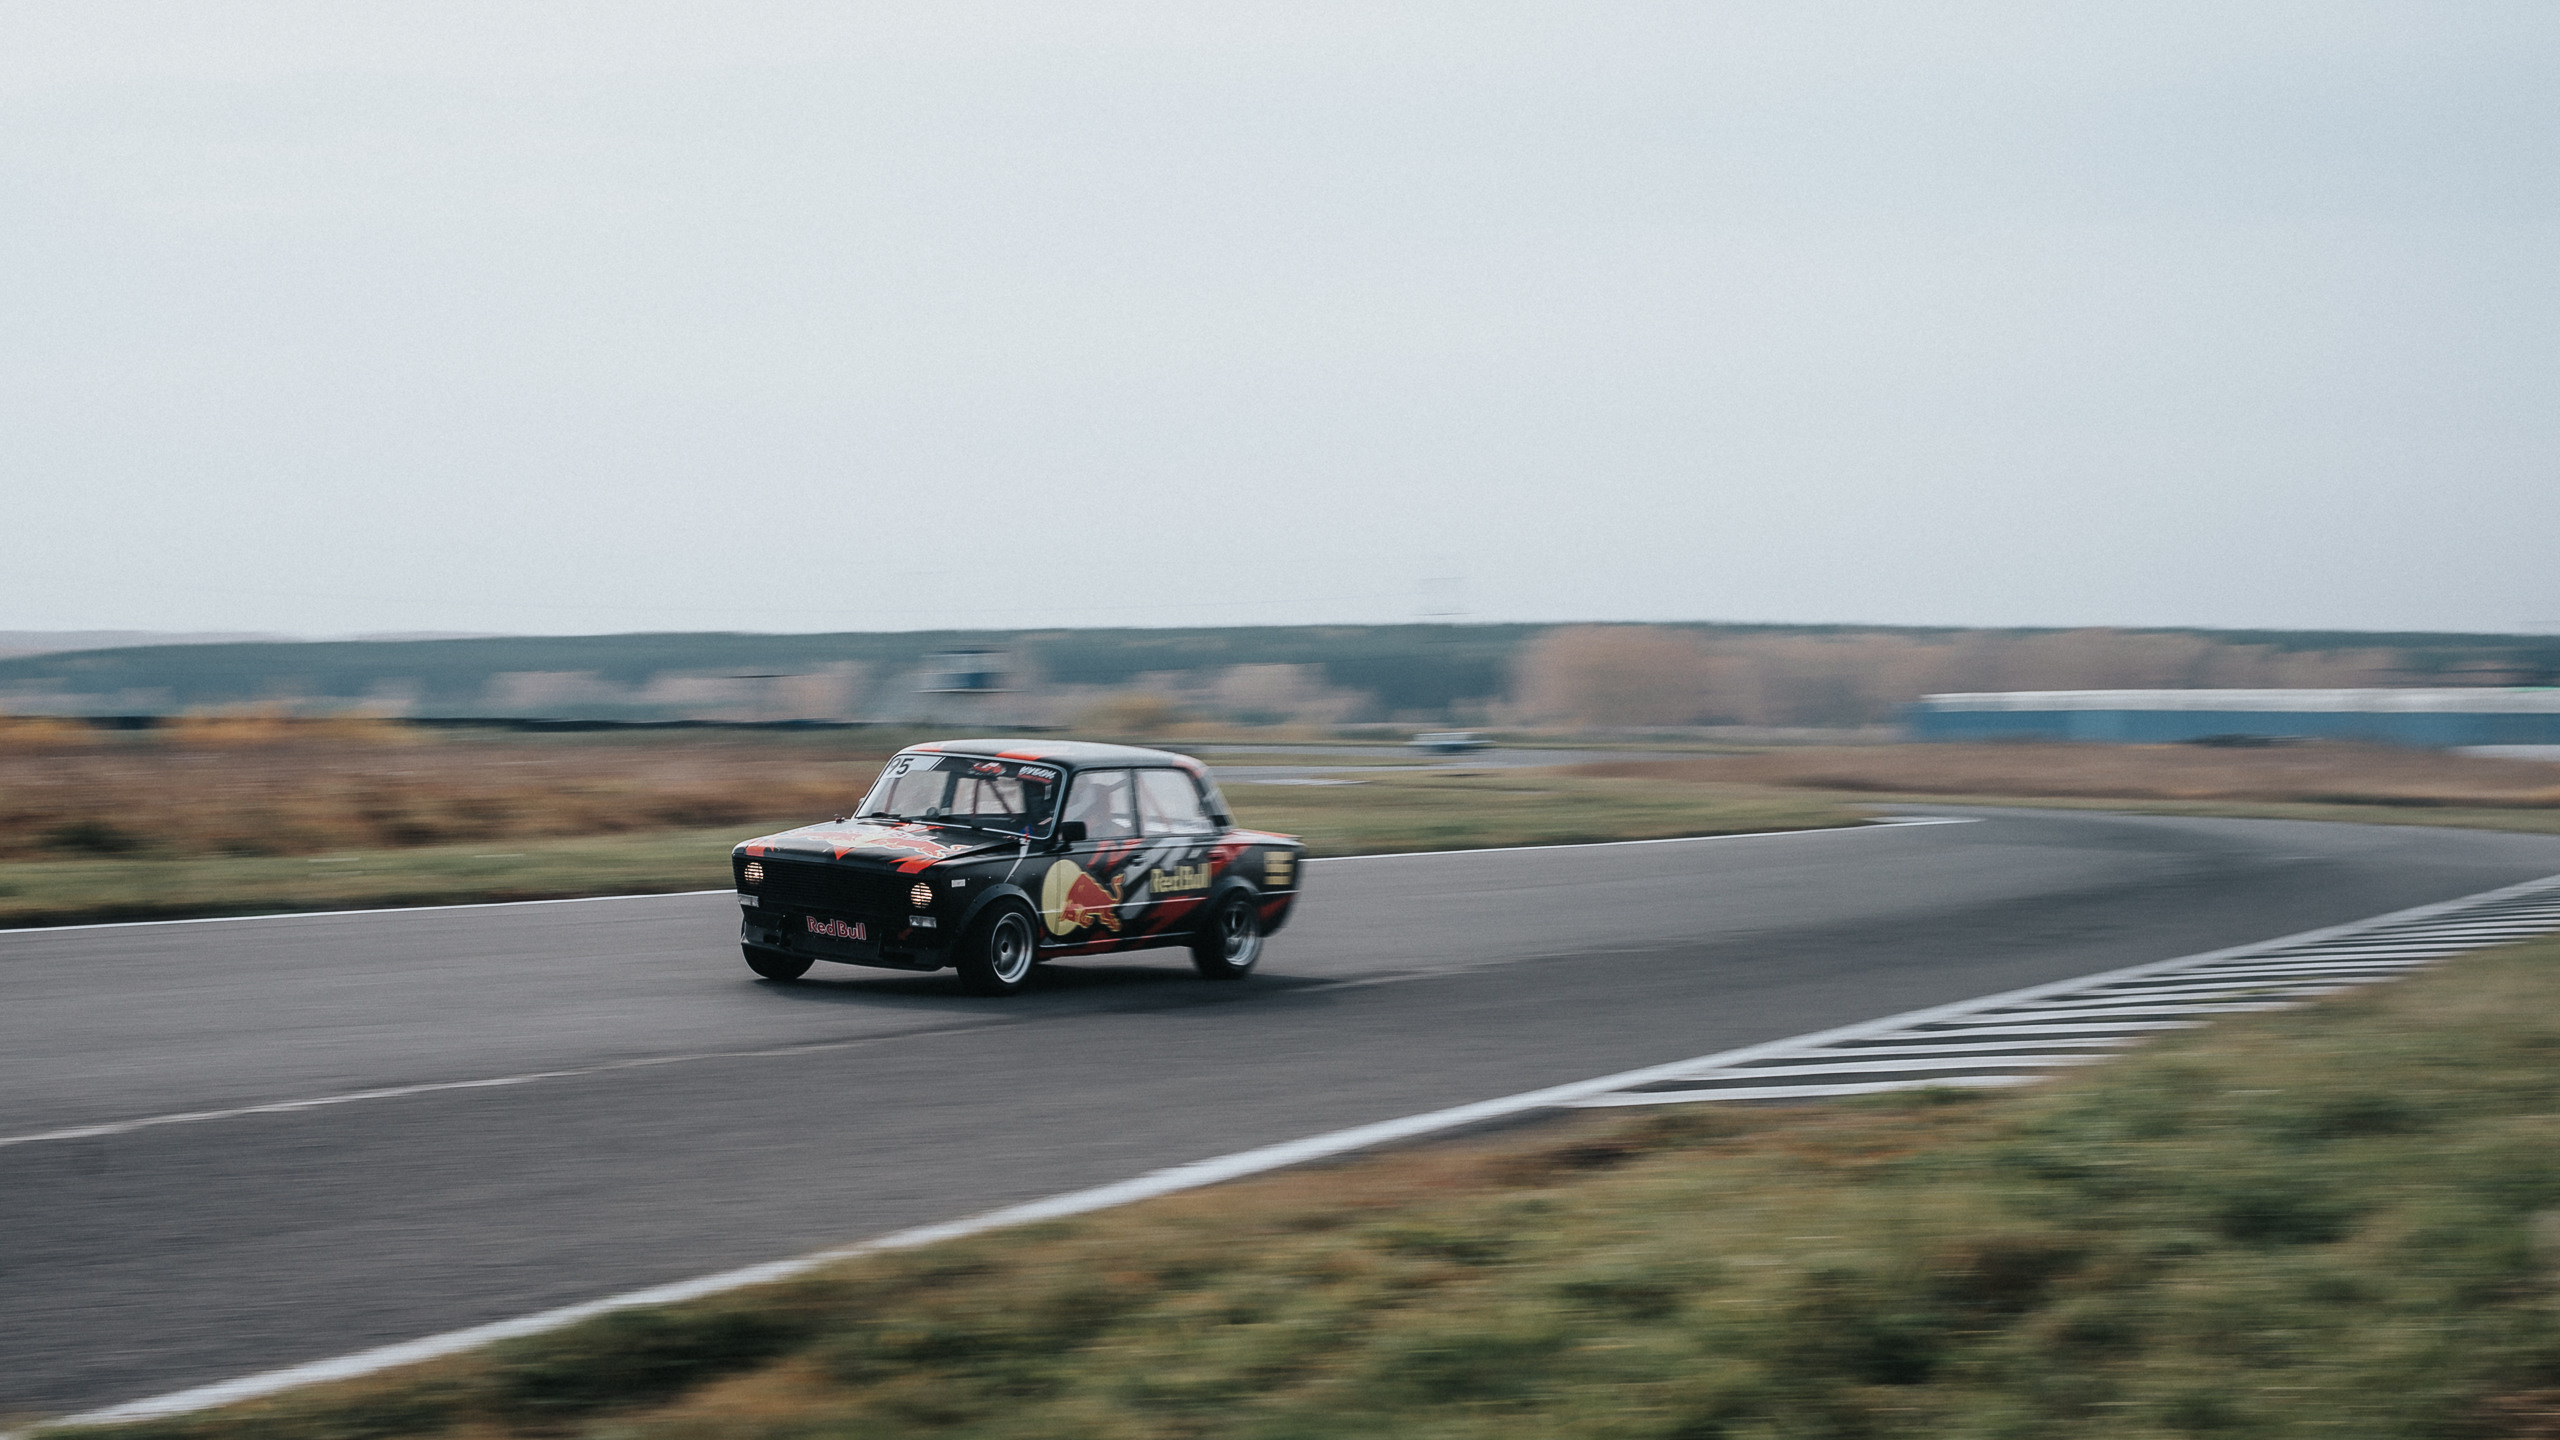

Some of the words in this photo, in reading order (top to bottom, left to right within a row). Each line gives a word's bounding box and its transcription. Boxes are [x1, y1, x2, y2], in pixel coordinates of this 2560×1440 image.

[887, 757, 914, 775] 95
[806, 915, 836, 936] Red
[836, 920, 867, 940] Bull
